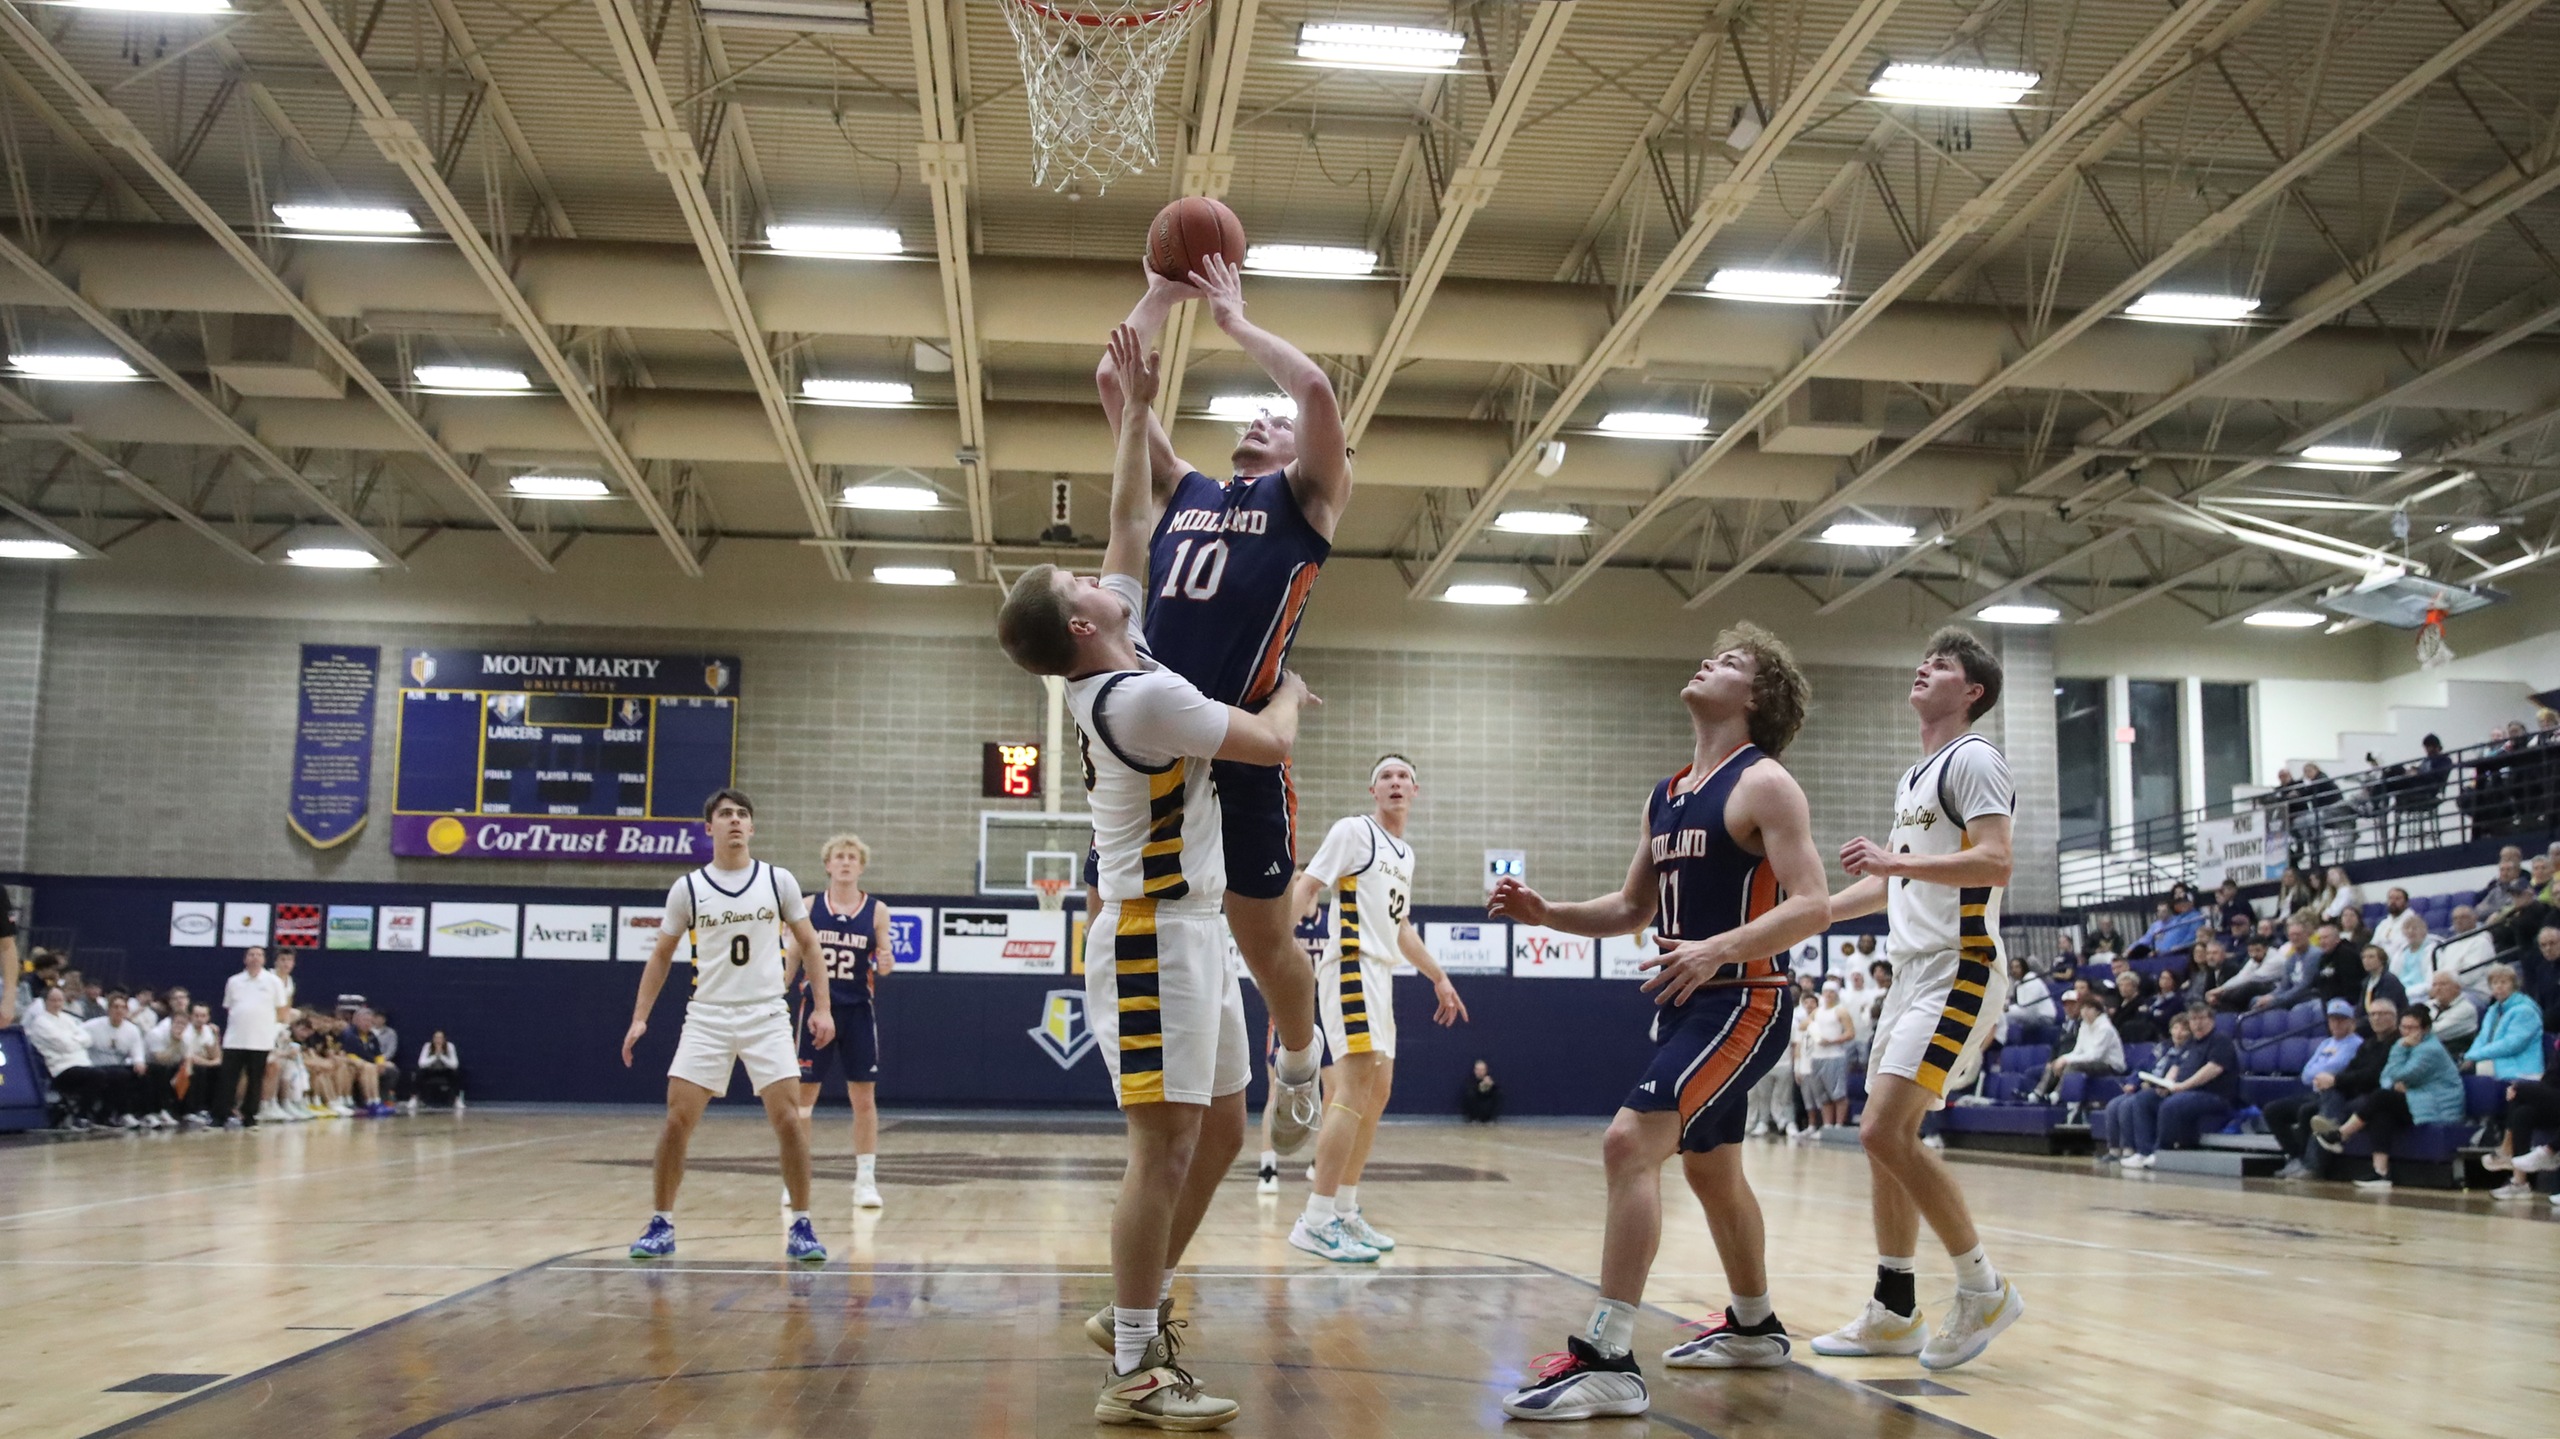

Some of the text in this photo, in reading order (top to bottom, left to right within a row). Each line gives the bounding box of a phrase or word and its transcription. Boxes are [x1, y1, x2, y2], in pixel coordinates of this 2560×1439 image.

[1165, 506, 1268, 535] MIDLAND
[1160, 538, 1229, 601] 10
[482, 654, 660, 678] MOUNT MARTY
[523, 680, 618, 692] UNIVERSITY
[488, 725, 643, 743] LANCERS GUEST
[1004, 765, 1031, 794] 15
[1915, 805, 1937, 831] City
[477, 823, 695, 855] CorTrust Bank
[1659, 869, 1682, 936] 11
[699, 906, 775, 928] The River City
[955, 918, 1008, 936] Parker
[529, 924, 587, 942] Avera
[731, 934, 750, 966] 0
[1004, 942, 1052, 957] BALDWIN
[824, 947, 855, 980] 22
